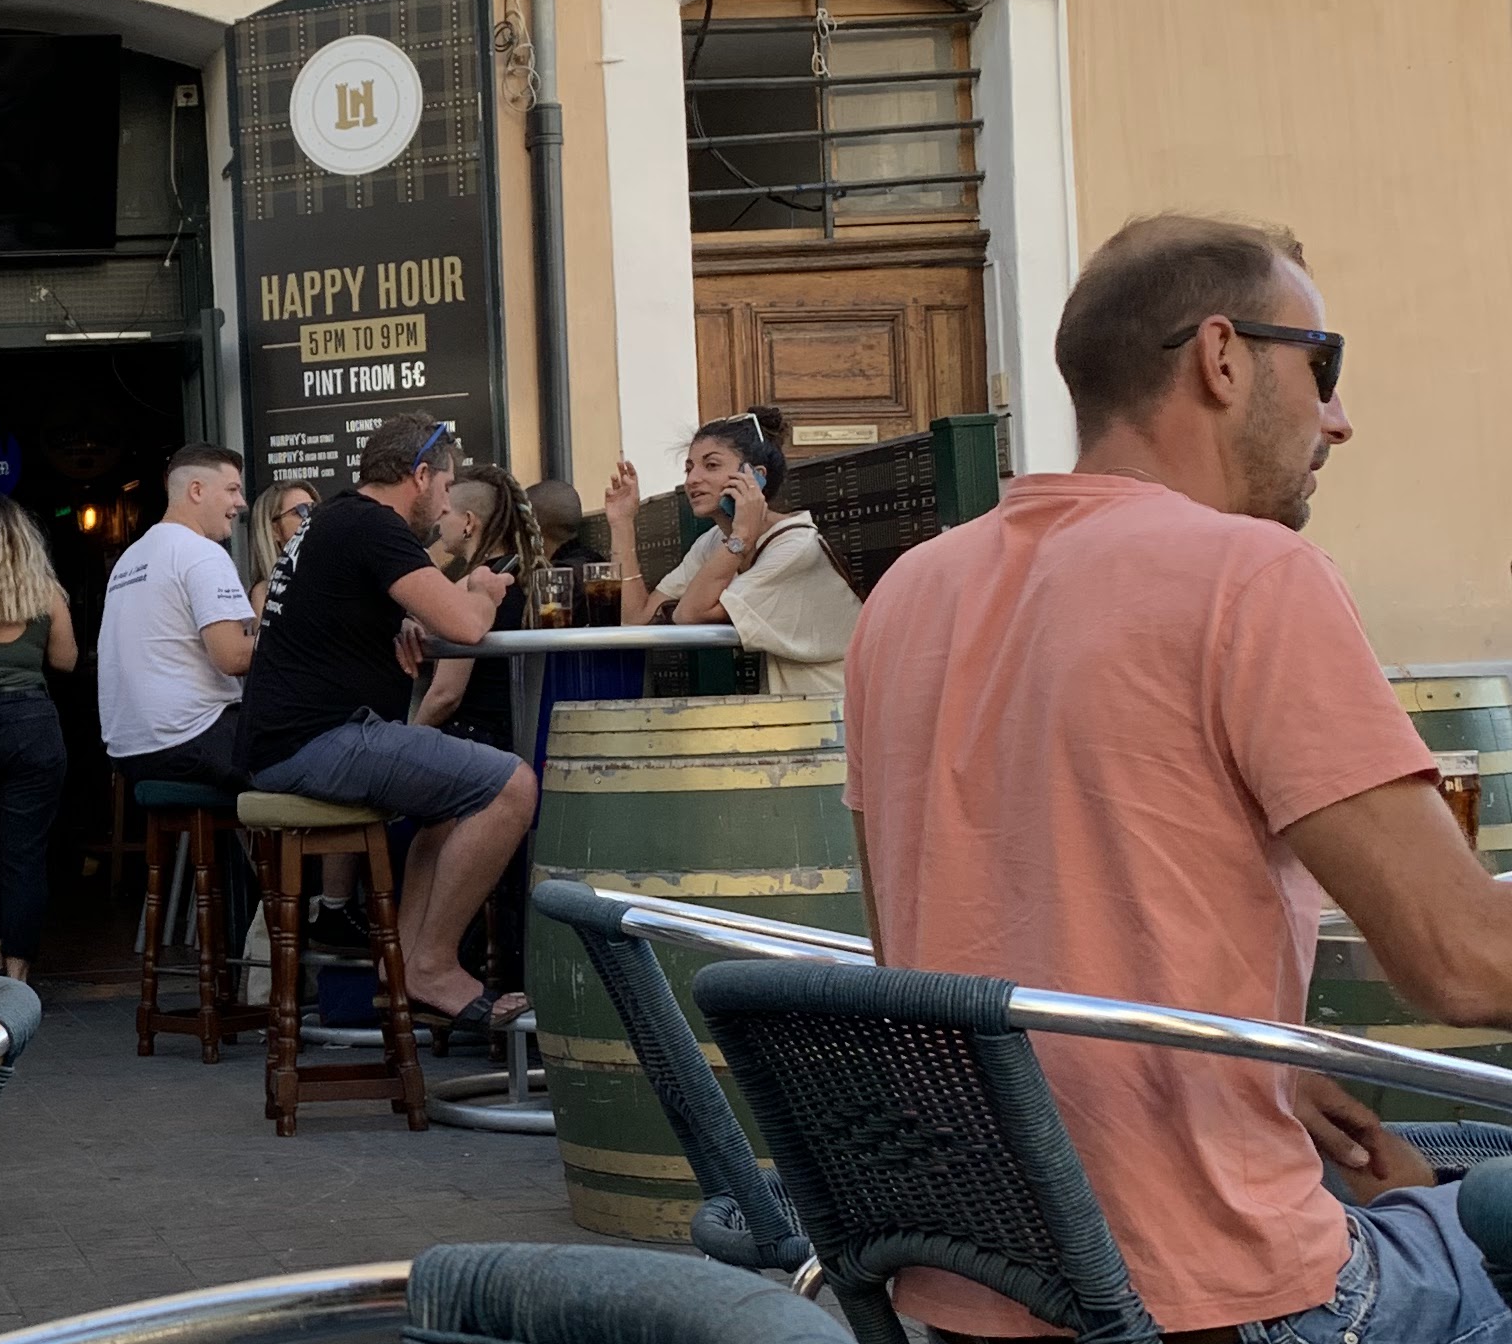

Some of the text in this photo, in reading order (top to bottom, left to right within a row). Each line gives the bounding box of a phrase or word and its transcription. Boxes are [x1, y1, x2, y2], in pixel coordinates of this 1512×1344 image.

[261, 256, 465, 321] HAPPY HOUR
[353, 326, 373, 352] TO
[303, 360, 425, 397] PINT FROM 5€
